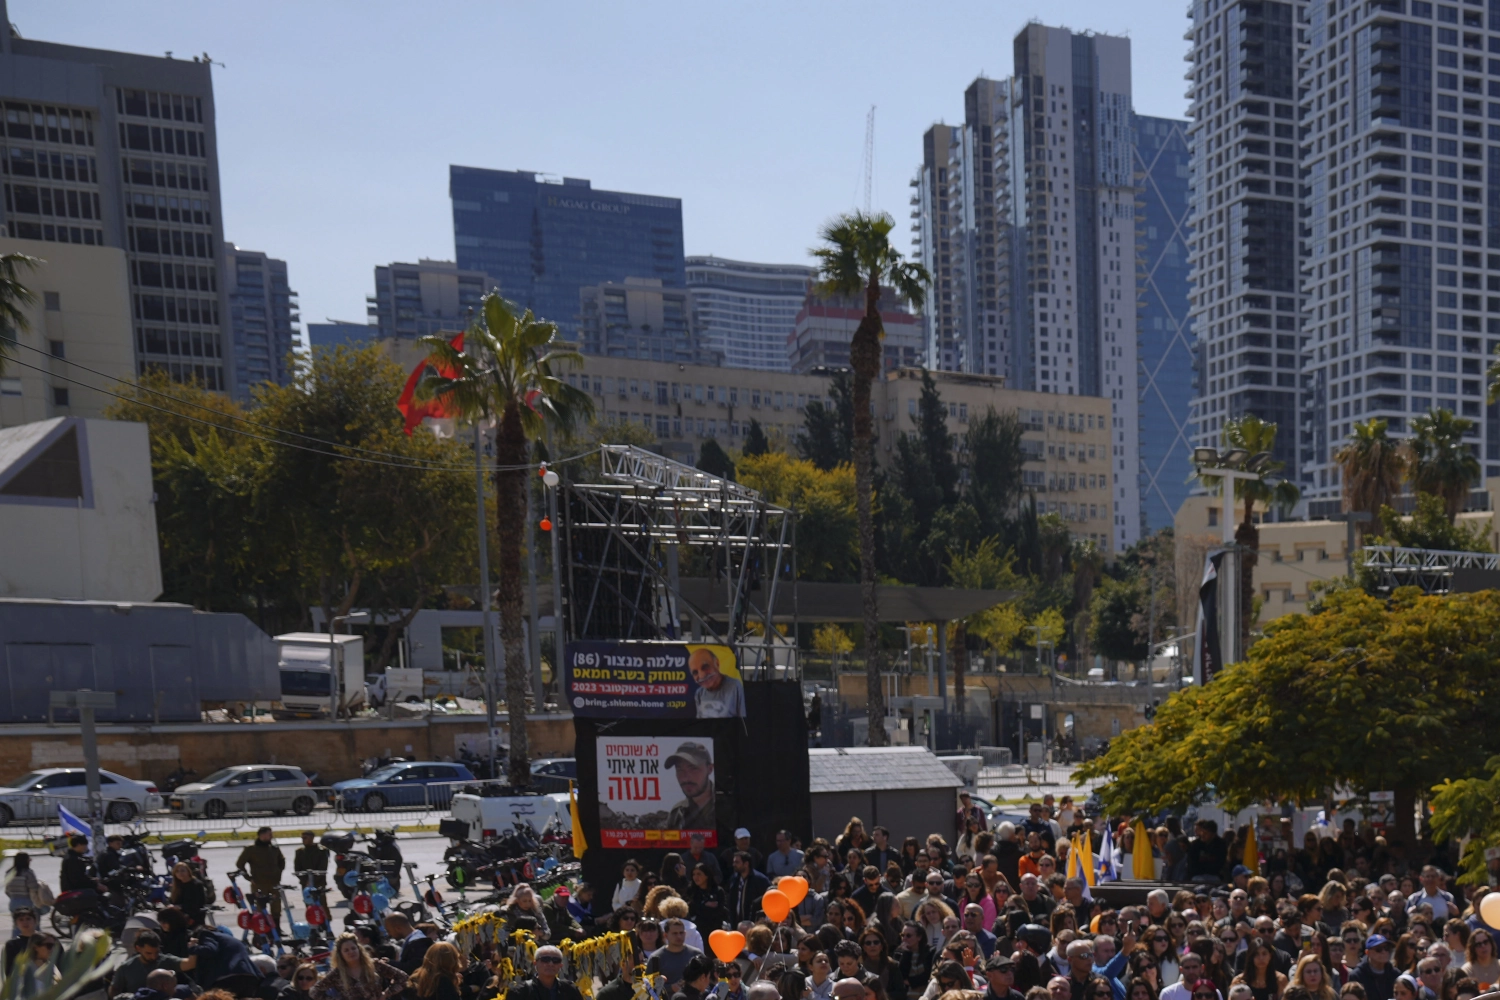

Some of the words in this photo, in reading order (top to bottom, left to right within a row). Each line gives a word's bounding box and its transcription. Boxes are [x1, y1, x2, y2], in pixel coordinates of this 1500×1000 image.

[573, 652, 600, 667] (86)
[603, 654, 643, 667] מנצור
[647, 655, 686, 667] שלמה
[573, 668, 610, 679] חמאס
[613, 669, 645, 680] בשבי
[648, 670, 686, 683] מוחזק
[573, 683, 597, 691] 2023
[600, 683, 646, 695] באוקטובר
[648, 685, 665, 693] ה-7
[667, 685, 686, 693] מאז
[585, 698, 664, 708] bring.shlomo.home
[606, 744, 643, 756] שוכחים
[646, 743, 659, 756] לא
[607, 759, 635, 774] איתי
[640, 759, 659, 774] את
[608, 777, 661, 800] בעזה
